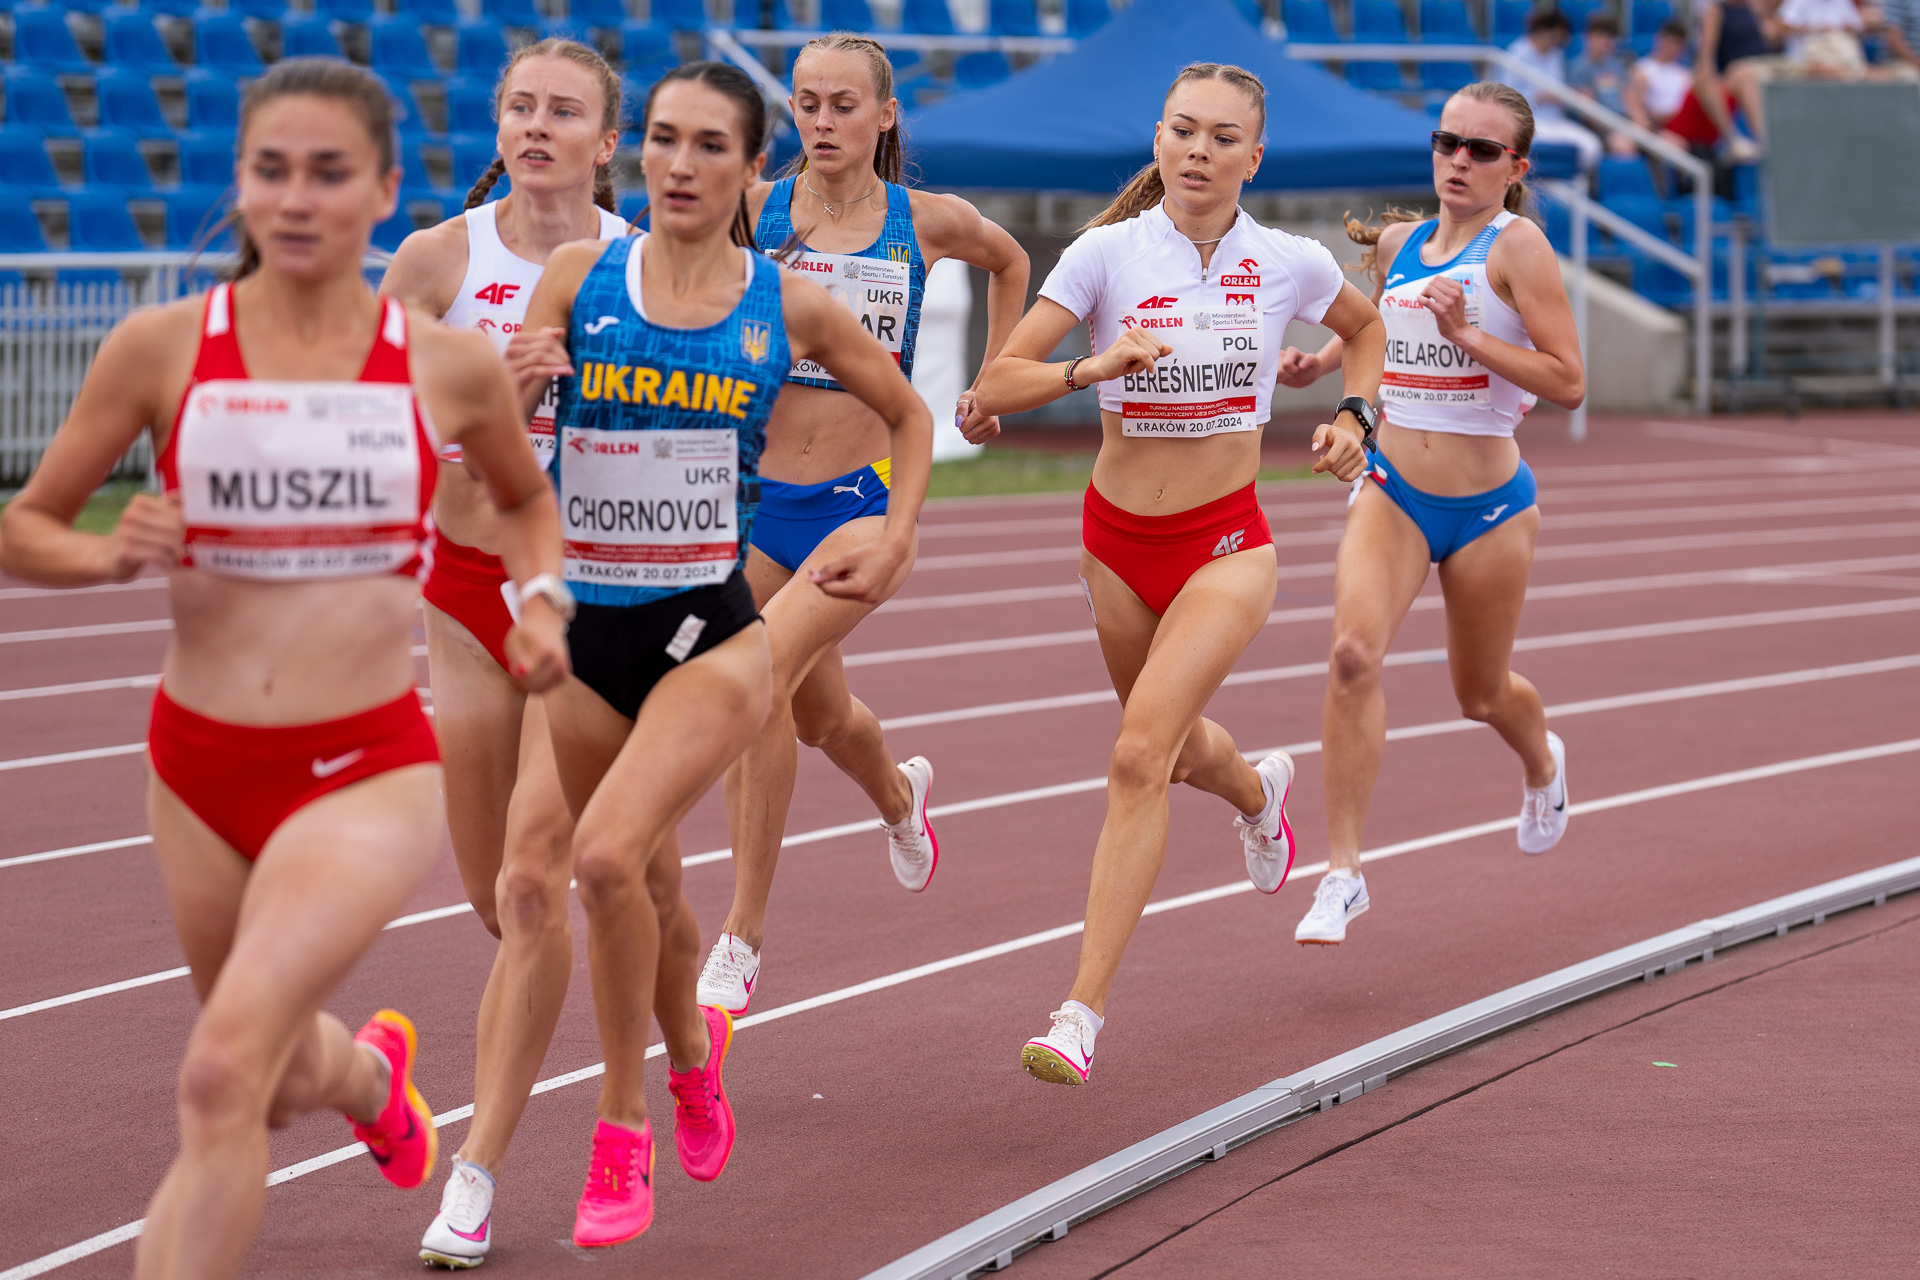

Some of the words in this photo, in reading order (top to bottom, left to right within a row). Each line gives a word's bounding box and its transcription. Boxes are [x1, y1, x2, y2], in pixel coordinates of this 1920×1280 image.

[792, 260, 834, 274] ORLEN
[861, 264, 895, 273] Ministerstwo
[861, 270, 879, 278] Sportu
[1222, 275, 1258, 286] ORLEN
[475, 282, 521, 305] 4F
[867, 288, 904, 306] UKR
[1140, 317, 1183, 329] ORLEN
[1222, 336, 1258, 351] POL
[1124, 358, 1258, 394] BEREŚNIEWICZ
[581, 362, 757, 420] UKRAINE
[1386, 388, 1422, 400] KRAKÓW
[1424, 391, 1476, 402] 20.07.2024
[1136, 420, 1187, 433] KRAKÓW
[1189, 416, 1243, 433] 20.07.2024
[348, 429, 406, 449] HUN
[593, 441, 640, 456] ORLEN
[685, 466, 731, 485] UKR
[207, 468, 389, 512] MUSZIL
[567, 495, 728, 533] CHORNOVOL
[578, 562, 639, 579] KRAKÓW
[642, 564, 718, 580] 20.07.2024
